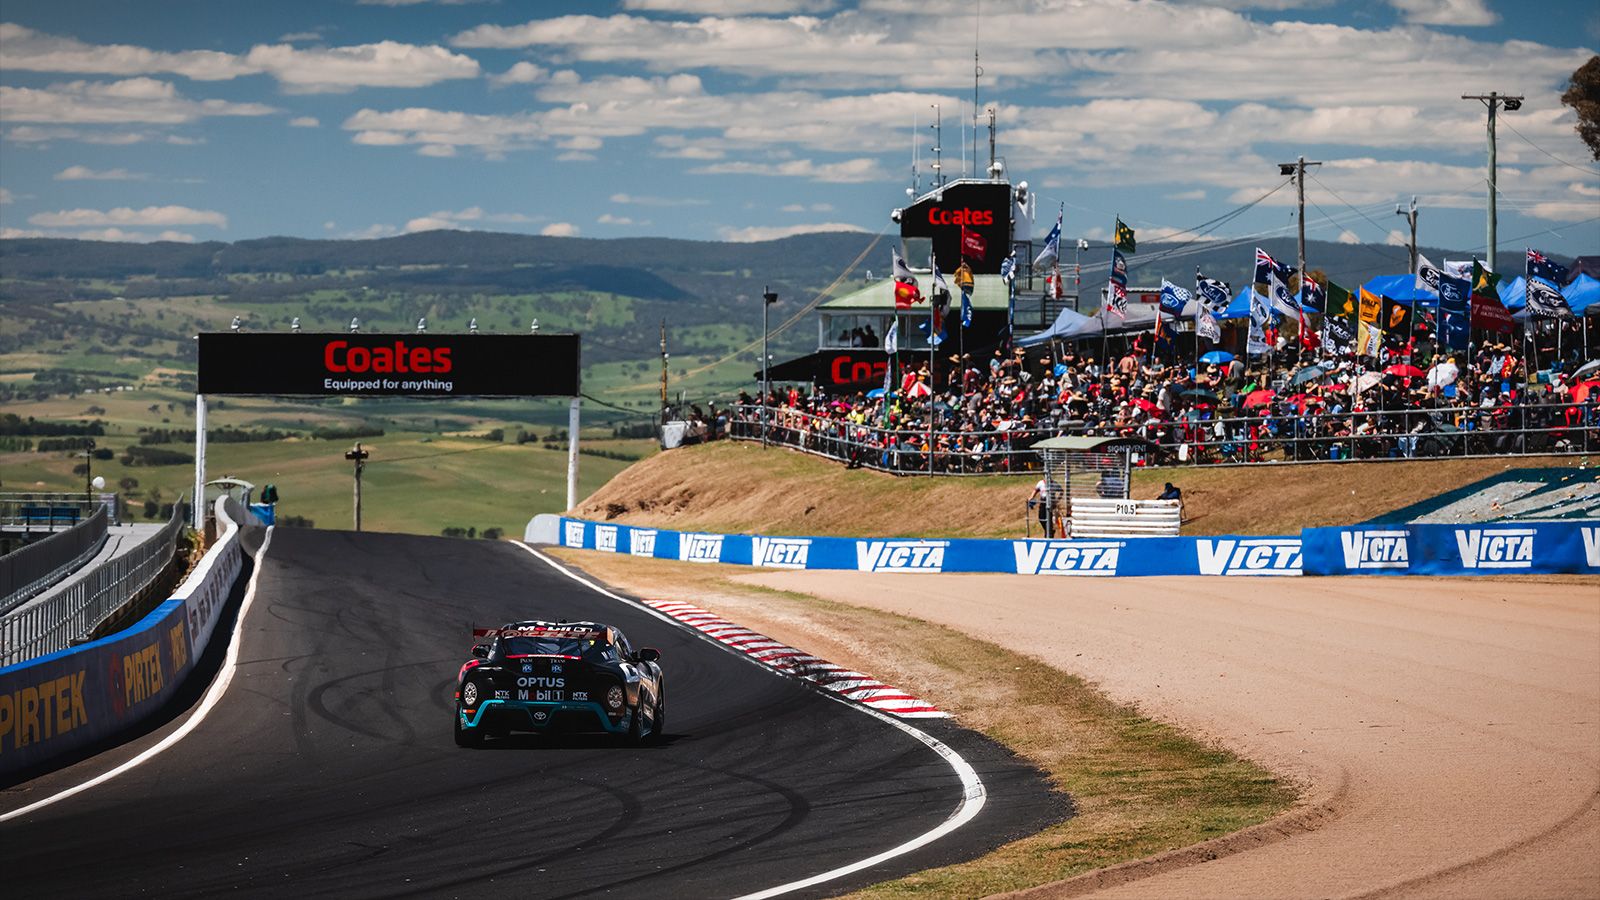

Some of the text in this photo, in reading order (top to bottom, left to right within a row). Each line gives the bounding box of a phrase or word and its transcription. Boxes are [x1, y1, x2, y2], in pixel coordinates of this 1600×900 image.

[928, 207, 993, 225] Coates
[324, 340, 453, 373] Coates
[324, 378, 453, 392] Equipped for anything
[1116, 504, 1135, 515] P10.5
[679, 533, 724, 563] VICTA
[752, 537, 812, 569] VICTA
[857, 541, 947, 572] VICTA
[1013, 541, 1120, 575] VICTA
[1341, 529, 1534, 568] VICTA VICTA
[124, 641, 164, 708] PIRTEK
[517, 677, 565, 687] OPTUS
[518, 690, 551, 700] Mobil
